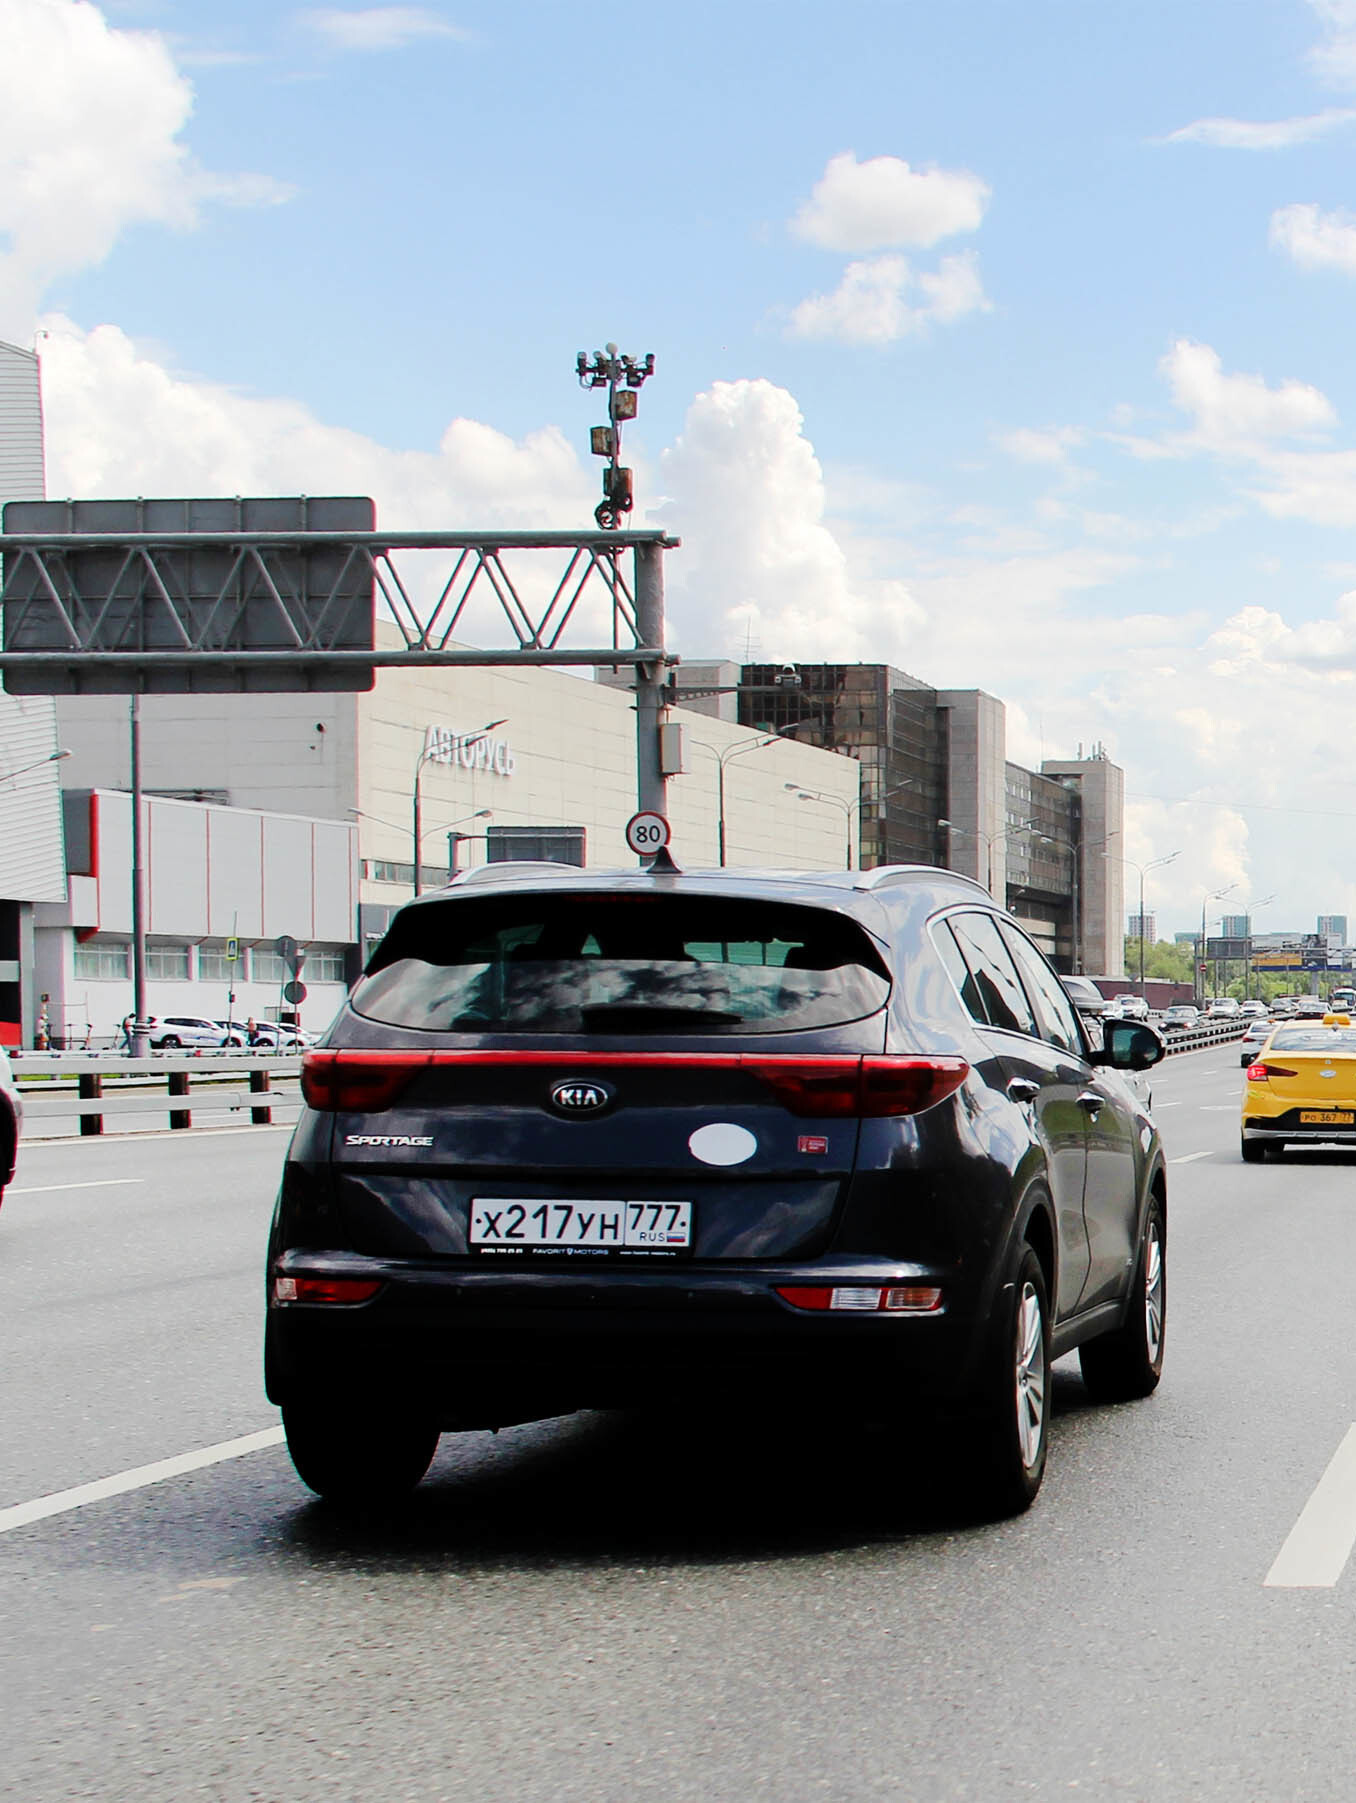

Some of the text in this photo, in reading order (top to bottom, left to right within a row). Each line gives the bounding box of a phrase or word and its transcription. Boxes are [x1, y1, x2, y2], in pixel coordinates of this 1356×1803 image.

[636, 825, 661, 843] 80
[560, 1089, 598, 1105] KIA
[345, 1135, 434, 1147] SPORTAGE
[629, 1203, 681, 1231] 777
[639, 1232, 665, 1242] RUS
